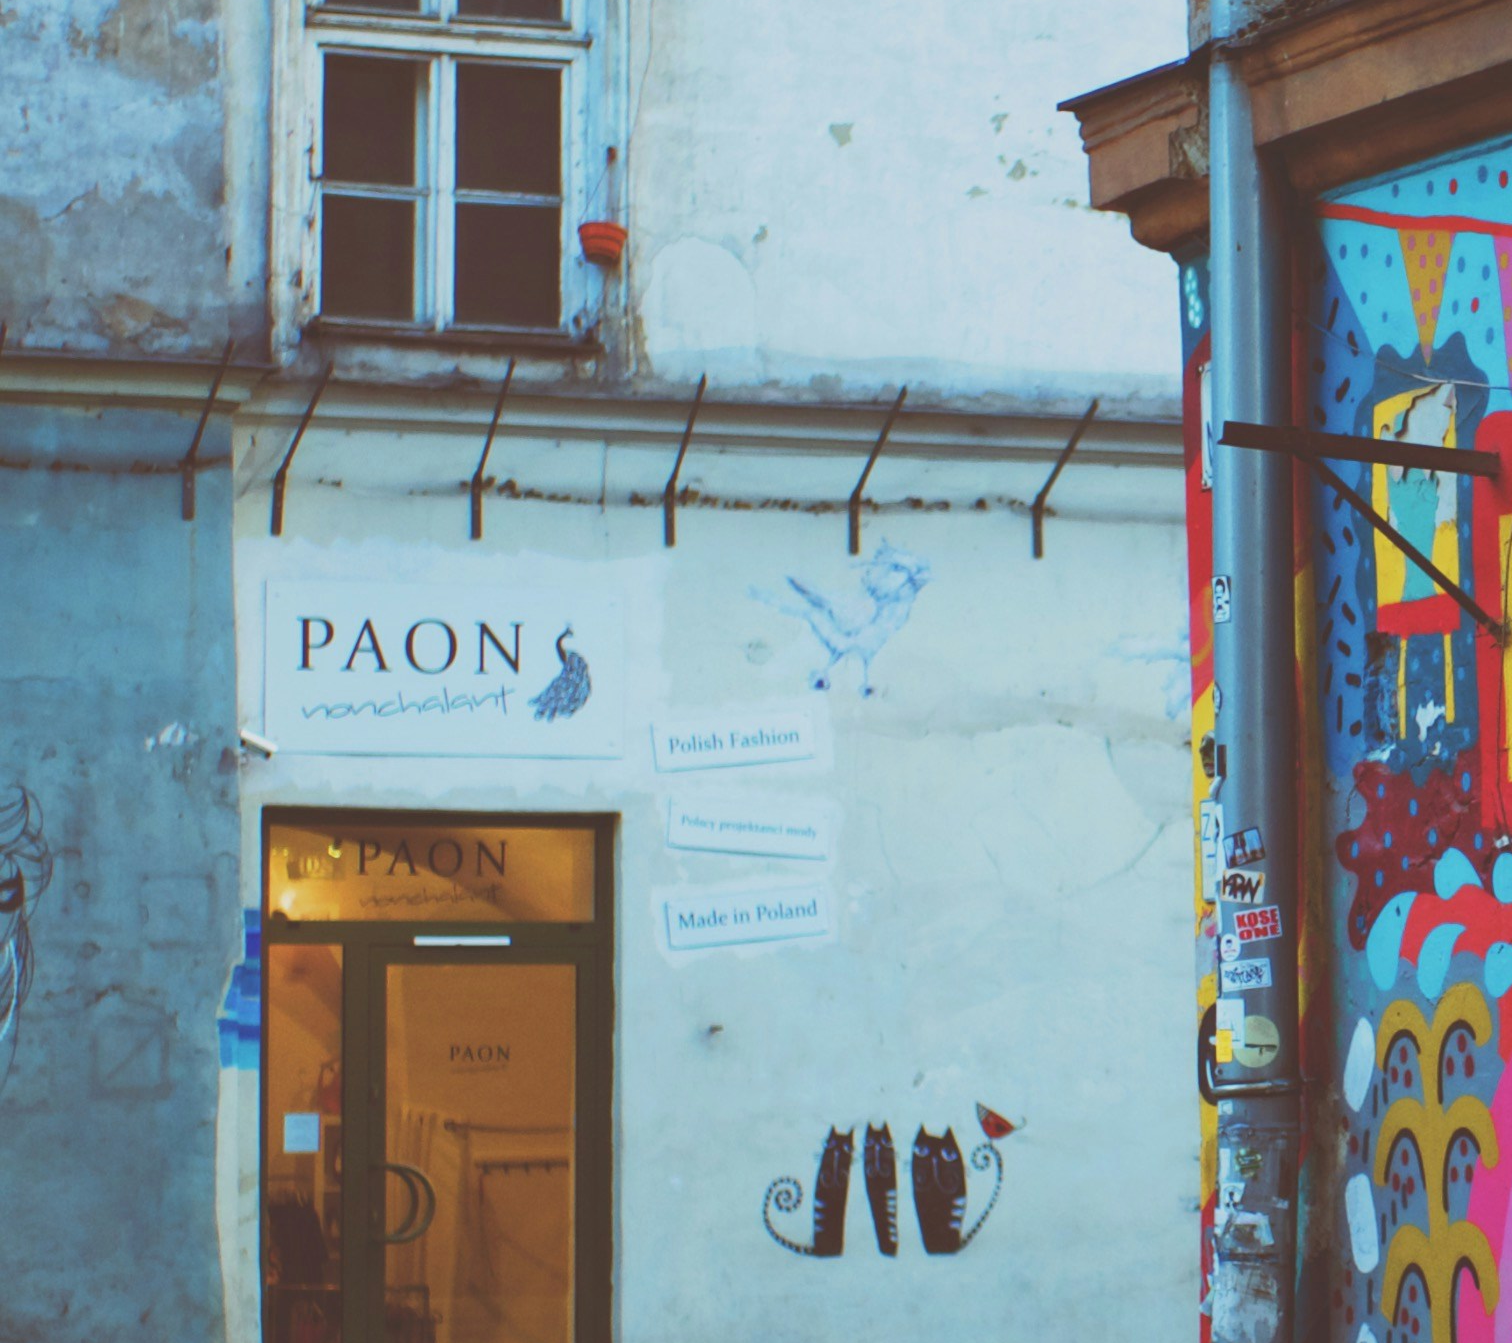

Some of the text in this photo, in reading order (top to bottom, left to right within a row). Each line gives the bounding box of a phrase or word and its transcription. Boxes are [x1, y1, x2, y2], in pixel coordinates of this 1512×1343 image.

[296, 615, 525, 675] PAON
[302, 683, 516, 720] nonchalant
[668, 728, 800, 755] Polish Fashion
[357, 839, 508, 878] PAON
[677, 898, 818, 931] Made in Poland
[1236, 908, 1279, 928] KOSE
[1239, 924, 1280, 941] ONE
[450, 1044, 510, 1062] PAON
